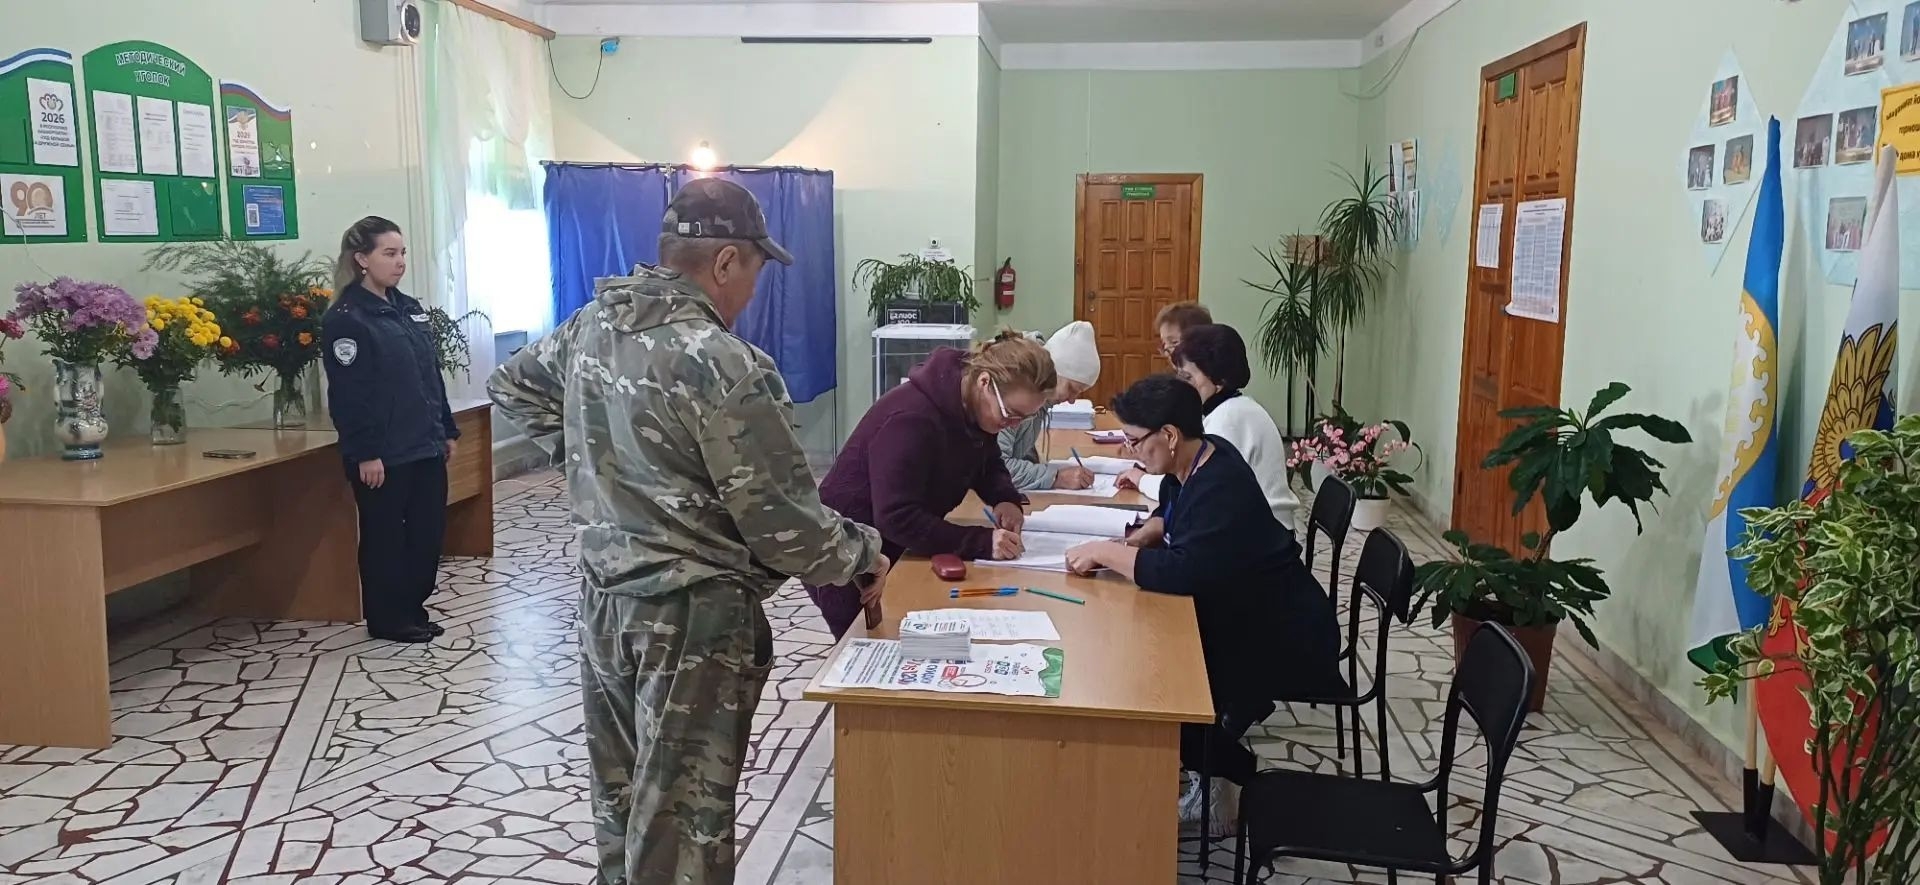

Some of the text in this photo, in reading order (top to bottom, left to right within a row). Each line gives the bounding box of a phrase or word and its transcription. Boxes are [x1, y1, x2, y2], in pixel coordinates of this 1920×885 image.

[115, 51, 186, 76] МЕТОДИЧЕСКИЙ
[134, 69, 170, 87] УГОЛОК
[41, 112, 65, 124] 2026
[10, 181, 54, 216] 90
